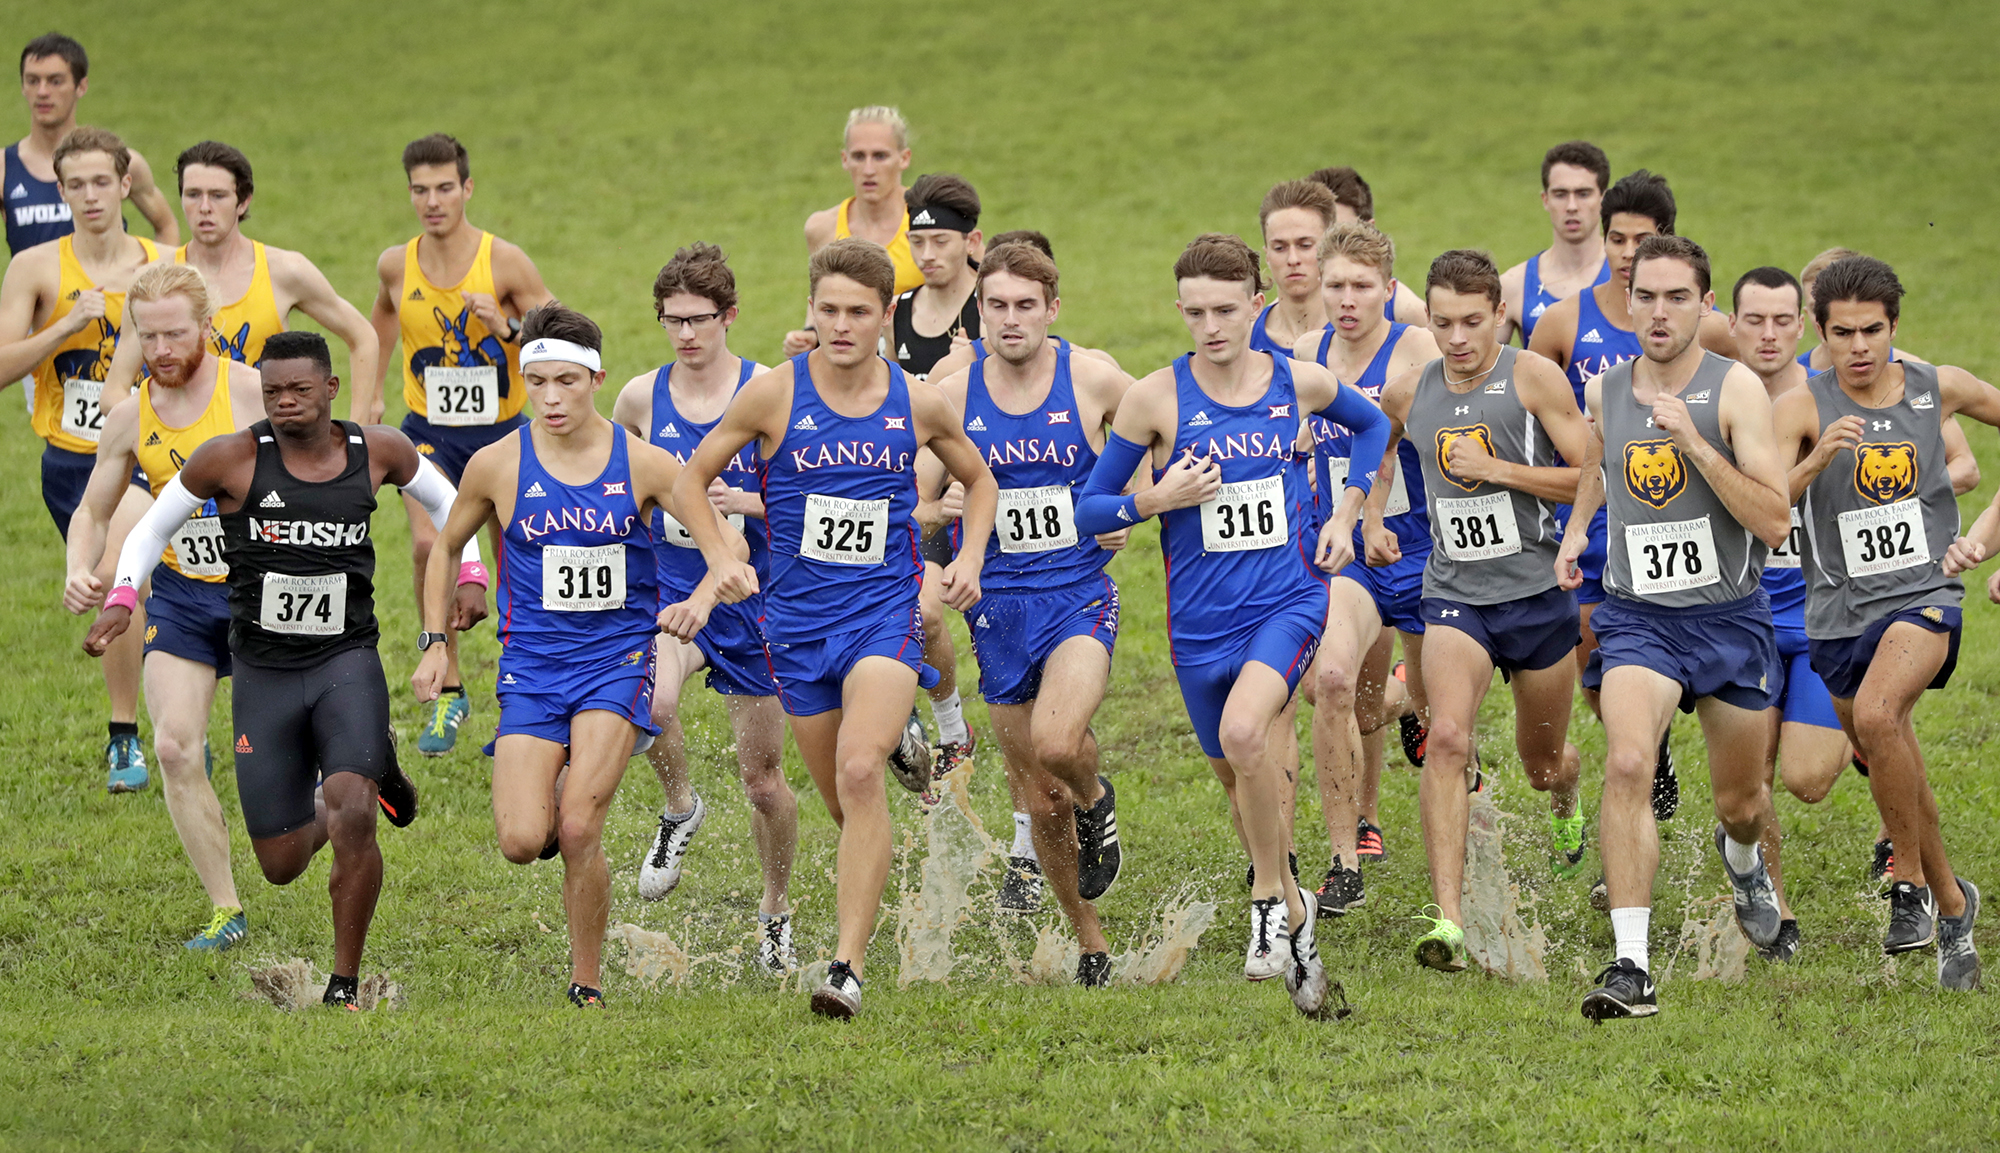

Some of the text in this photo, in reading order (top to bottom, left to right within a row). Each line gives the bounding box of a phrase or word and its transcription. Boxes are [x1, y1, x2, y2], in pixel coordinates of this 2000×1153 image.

[470, 369, 492, 377] FARM
[439, 386, 485, 413] 329
[74, 399, 102, 429] 32
[791, 441, 909, 473] KANSAS
[988, 439, 1078, 467] ANSAS
[1015, 490, 1038, 500] ROCK
[1040, 488, 1064, 497] FARM
[1228, 484, 1253, 495] ROCK
[1256, 480, 1278, 491] FARM
[1009, 498, 1052, 507] COLLEGIATE
[1220, 492, 1267, 502] COLLEGIATE
[1441, 494, 1505, 508] RIM ROCK FARM
[814, 498, 883, 511] RIM ROCK FARM
[1451, 506, 1494, 515] COLLEGIATE
[825, 509, 871, 518] COLLEGIATE
[1845, 502, 1914, 522] RIM ROCK FARM
[518, 507, 634, 542] KANSAS
[1007, 506, 1061, 541] 318
[1217, 500, 1274, 539] 316
[1859, 514, 1904, 527] COLLEGIATE
[249, 517, 366, 547] NEOSHO
[817, 517, 874, 552] 325
[1451, 514, 1504, 549] 381
[1632, 522, 1704, 536] RIM ROCK FARM
[1006, 542, 1037, 550] UNIVERSITY
[1049, 538, 1071, 547] KANSAS
[1211, 540, 1249, 549] UNIVERSITY
[1261, 536, 1283, 545] KANSAS
[1645, 533, 1691, 542] COLLEGIATE
[1857, 522, 1914, 562] 382
[550, 547, 620, 558] RIM ROCK FARM
[807, 548, 844, 560] UNIVERSITY
[1450, 544, 1516, 558] UNIVERSITY OF KANSAS
[1643, 541, 1702, 580] 378
[1854, 562, 1890, 573] UNIVERSITY
[1902, 555, 1924, 565] KANSAS
[272, 576, 342, 586] RIM ROCK FARM
[559, 566, 611, 598] 319
[1640, 581, 1677, 591] UNIVERSITY
[1689, 574, 1714, 585] KANSAS
[277, 592, 331, 623] 374
[550, 600, 586, 609] UNIVERSITY
